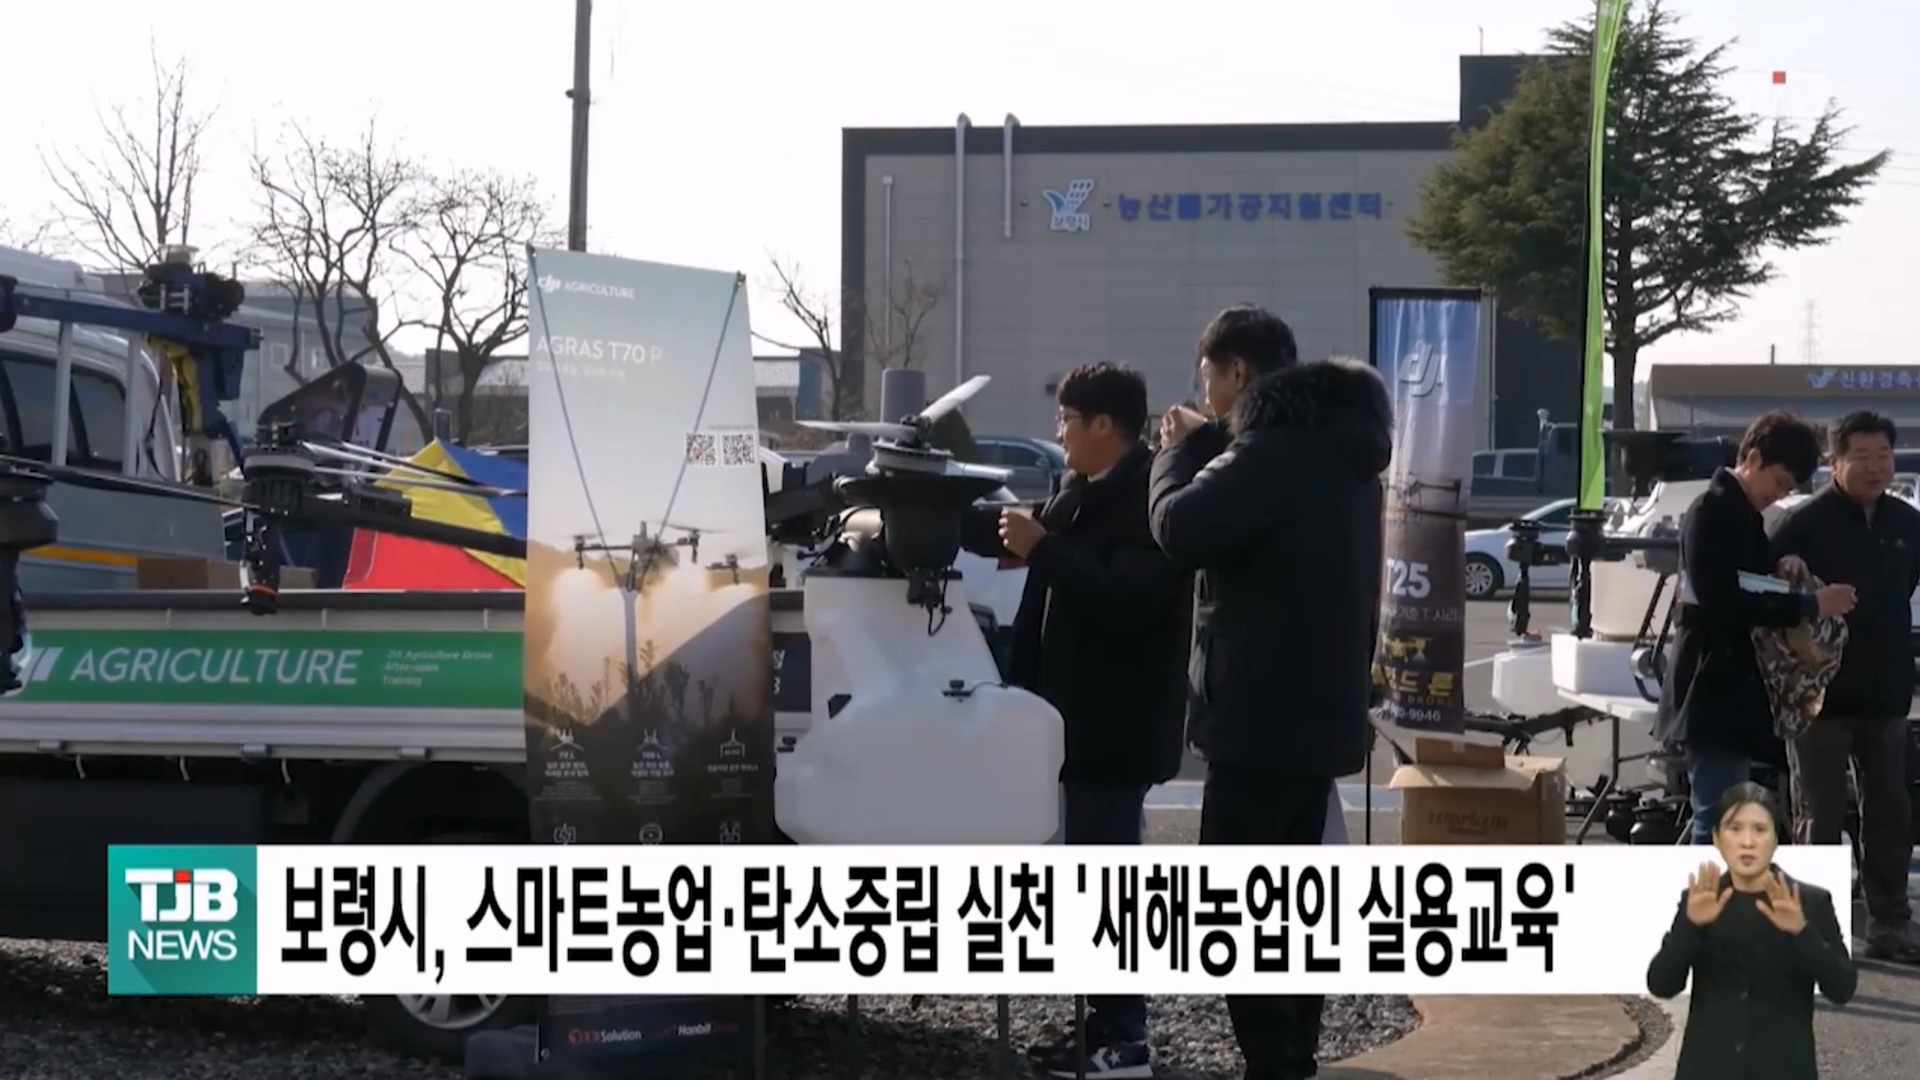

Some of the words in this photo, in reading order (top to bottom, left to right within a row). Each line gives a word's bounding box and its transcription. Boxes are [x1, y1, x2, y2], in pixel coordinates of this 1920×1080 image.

[564, 280, 636, 300] AGRICULTURE
[537, 335, 603, 360] AGRAS
[70, 647, 363, 685] AGRICULTURE
